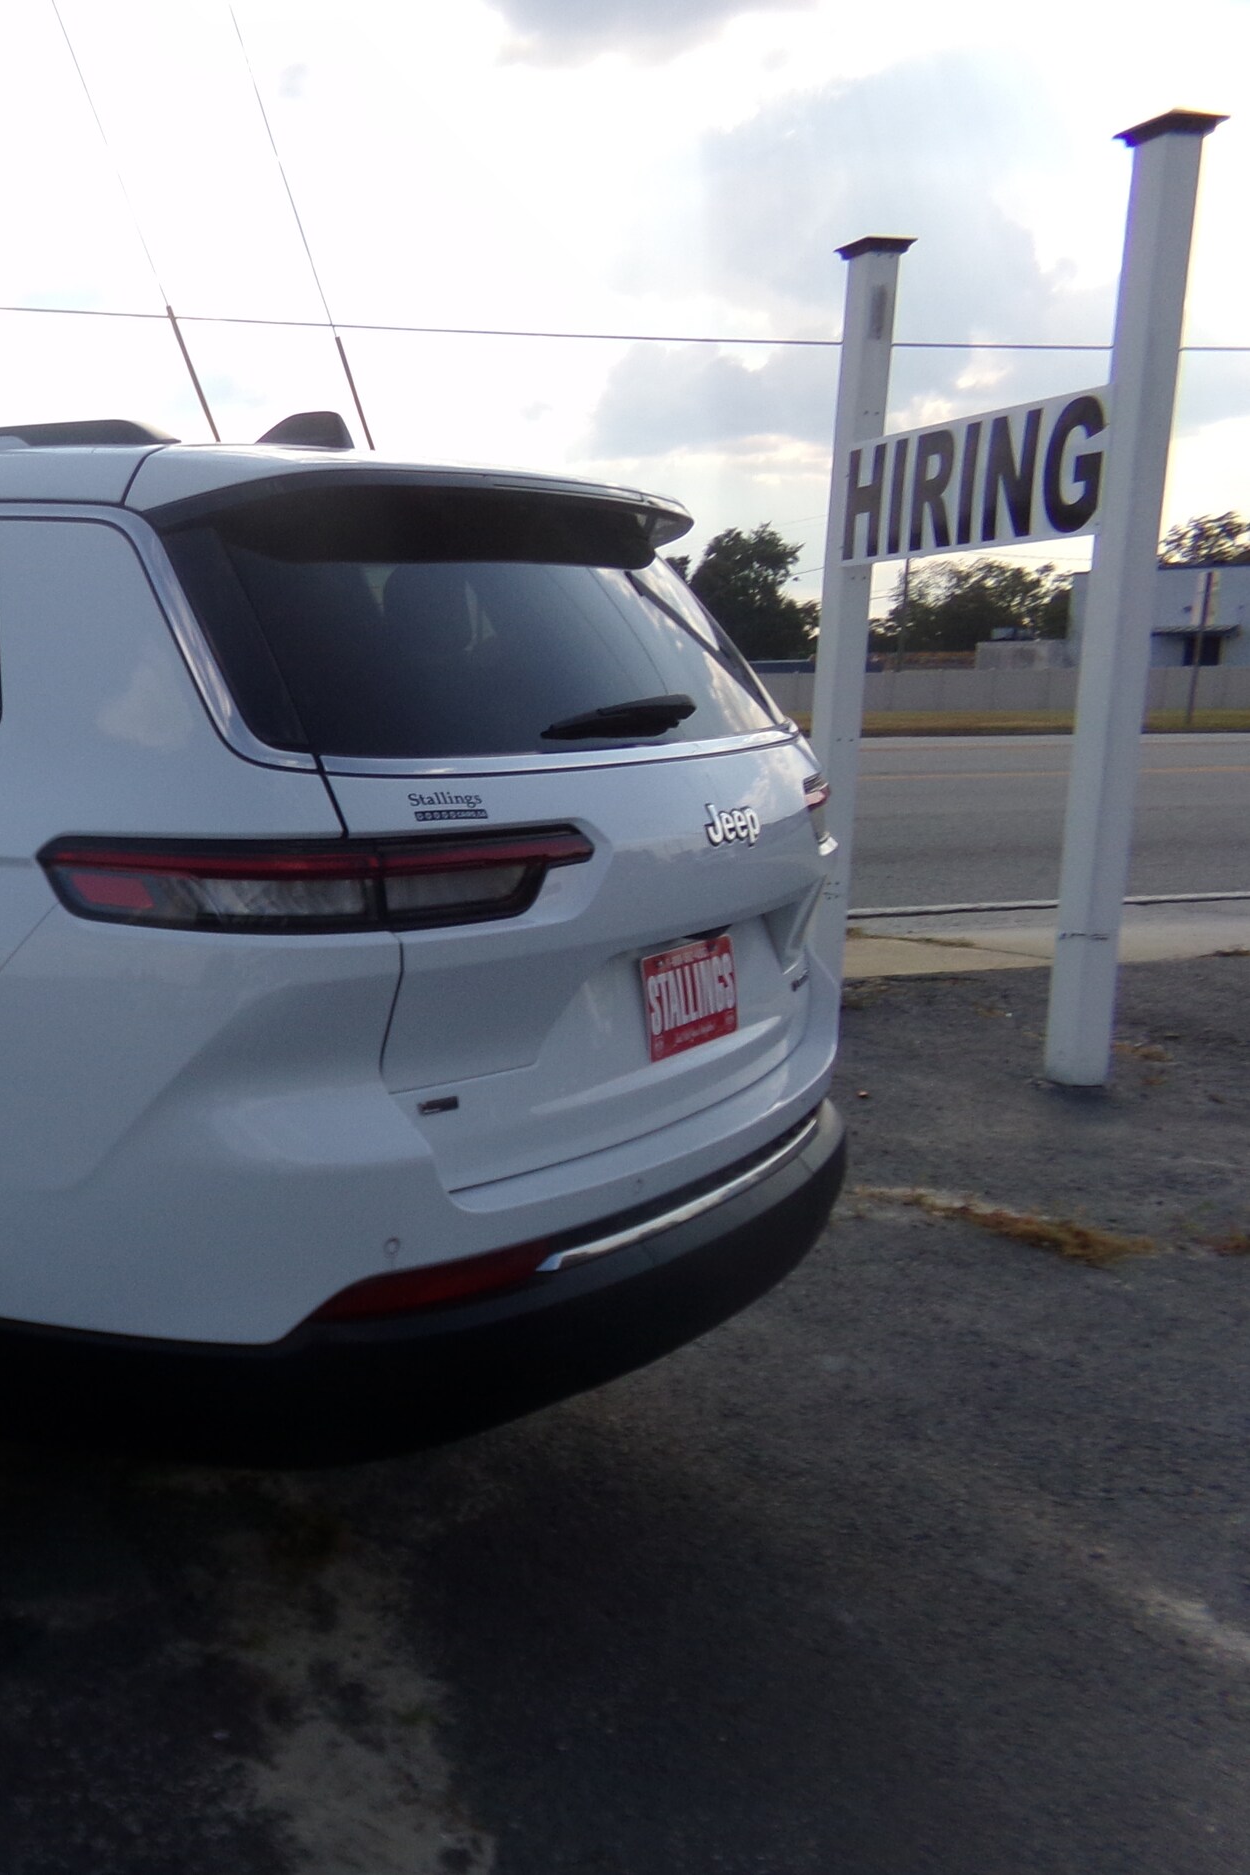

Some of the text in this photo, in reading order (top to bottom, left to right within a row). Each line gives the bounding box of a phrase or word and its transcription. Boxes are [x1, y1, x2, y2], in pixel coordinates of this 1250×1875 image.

[842, 396, 1108, 561] HIRING
[408, 792, 483, 808] Stallings
[704, 803, 761, 847] Jeep
[648, 953, 735, 1036] STALLINGS
